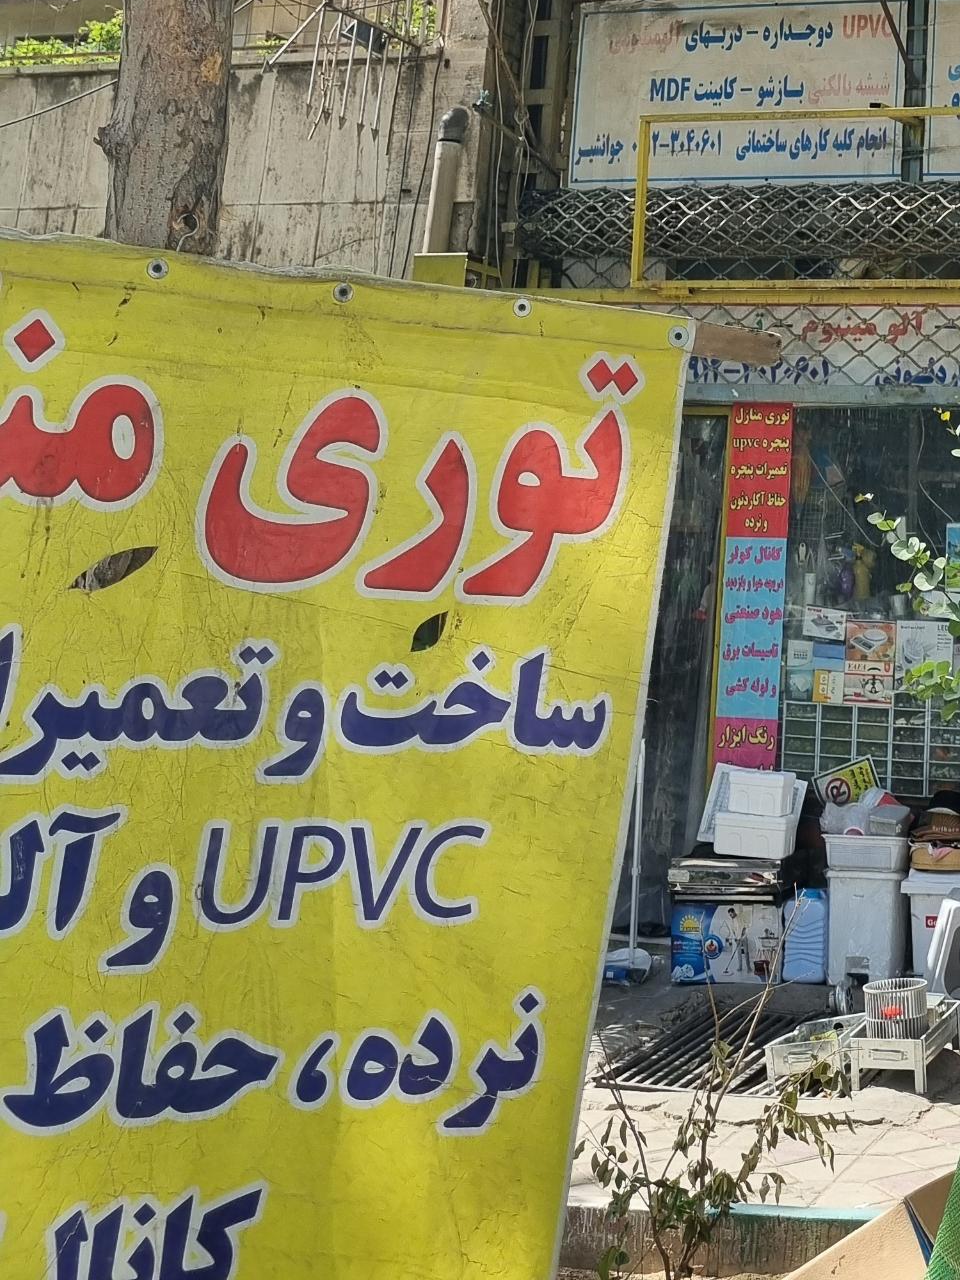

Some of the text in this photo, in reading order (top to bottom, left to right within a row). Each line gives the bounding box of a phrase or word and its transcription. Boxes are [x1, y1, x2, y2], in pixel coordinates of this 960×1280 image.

[685, 20, 743, 53] دربهای
[762, 18, 833, 49] دوجداره
[842, 13, 894, 40] UPVC
[650, 77, 691, 102] MDF
[693, 75, 738, 107] کابینت
[756, 74, 805, 107] بازشو
[575, 133, 624, 165] جوانشیر
[735, 127, 788, 161] ساختمانی
[789, 126, 831, 160] کارهای
[833, 126, 855, 153] کلیه
[856, 126, 888, 158] انجام
[735, 407, 791, 425] توری منازل
[733, 436, 790, 452] پنجره upvc
[203, 353, 640, 600] توری
[730, 462, 788, 480] تعمیرات پنجره
[730, 491, 786, 510] حفاظ آکاردئون
[727, 545, 783, 565] کانال کولر
[725, 605, 782, 625] هود صنعتی
[722, 643, 741, 661] برق
[343, 650, 609, 753] ساخت
[725, 677, 776, 698] و لوله کشی
[261, 677, 323, 780] و
[717, 724, 775, 750] رنگ ابزار
[199, 822, 484, 926] UPVC
[105, 869, 175, 969] و
[6, 1007, 278, 1130] حفاظ
